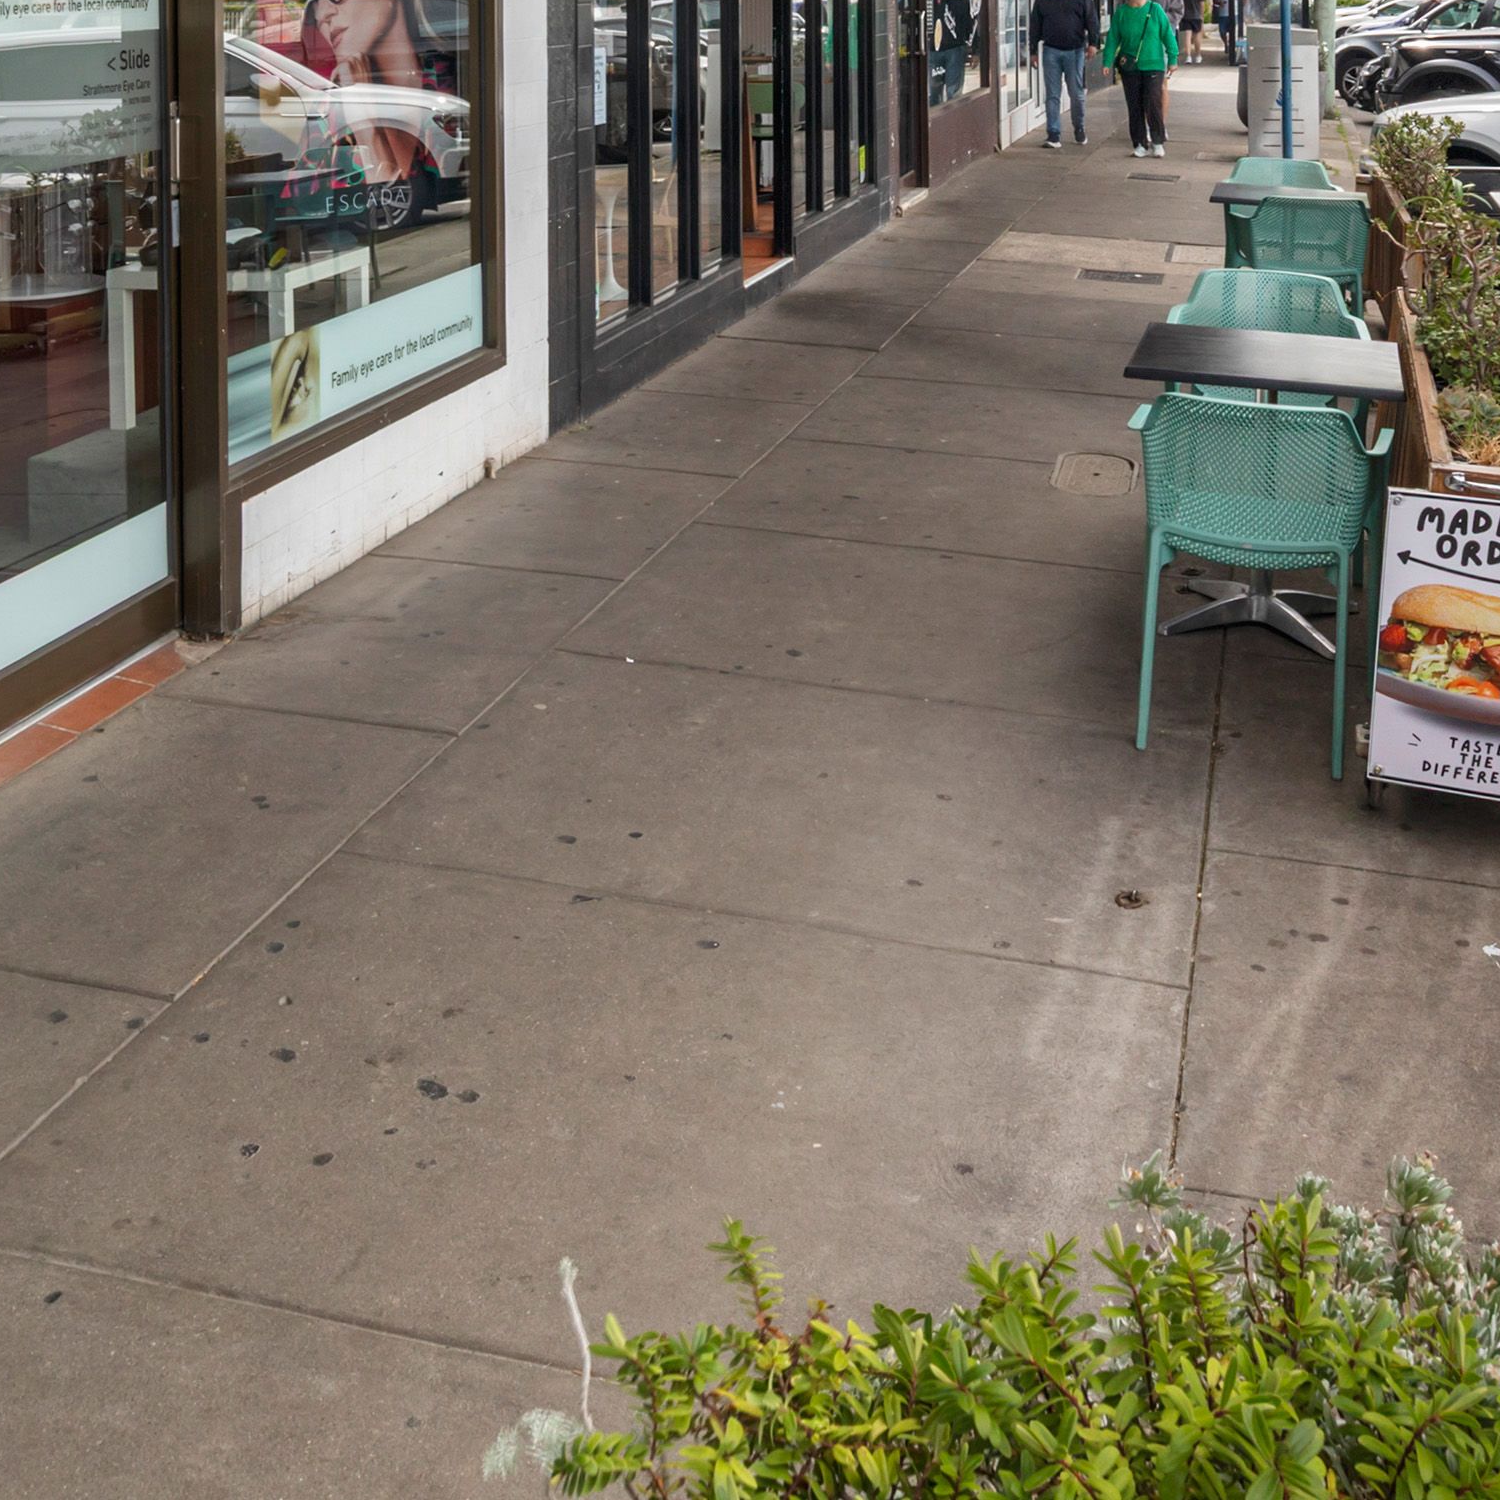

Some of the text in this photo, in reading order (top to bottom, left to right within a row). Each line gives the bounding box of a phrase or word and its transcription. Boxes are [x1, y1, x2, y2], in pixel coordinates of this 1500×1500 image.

[13, 2, 29, 16] eye
[31, 0, 52, 14] care
[119, 49, 150, 70] Slide
[83, 77, 151, 98] Strathmore Eye Care
[325, 186, 406, 214] ESCADA
[331, 314, 474, 389] Family eye care for the local community
[1460, 752, 1494, 769] THE
